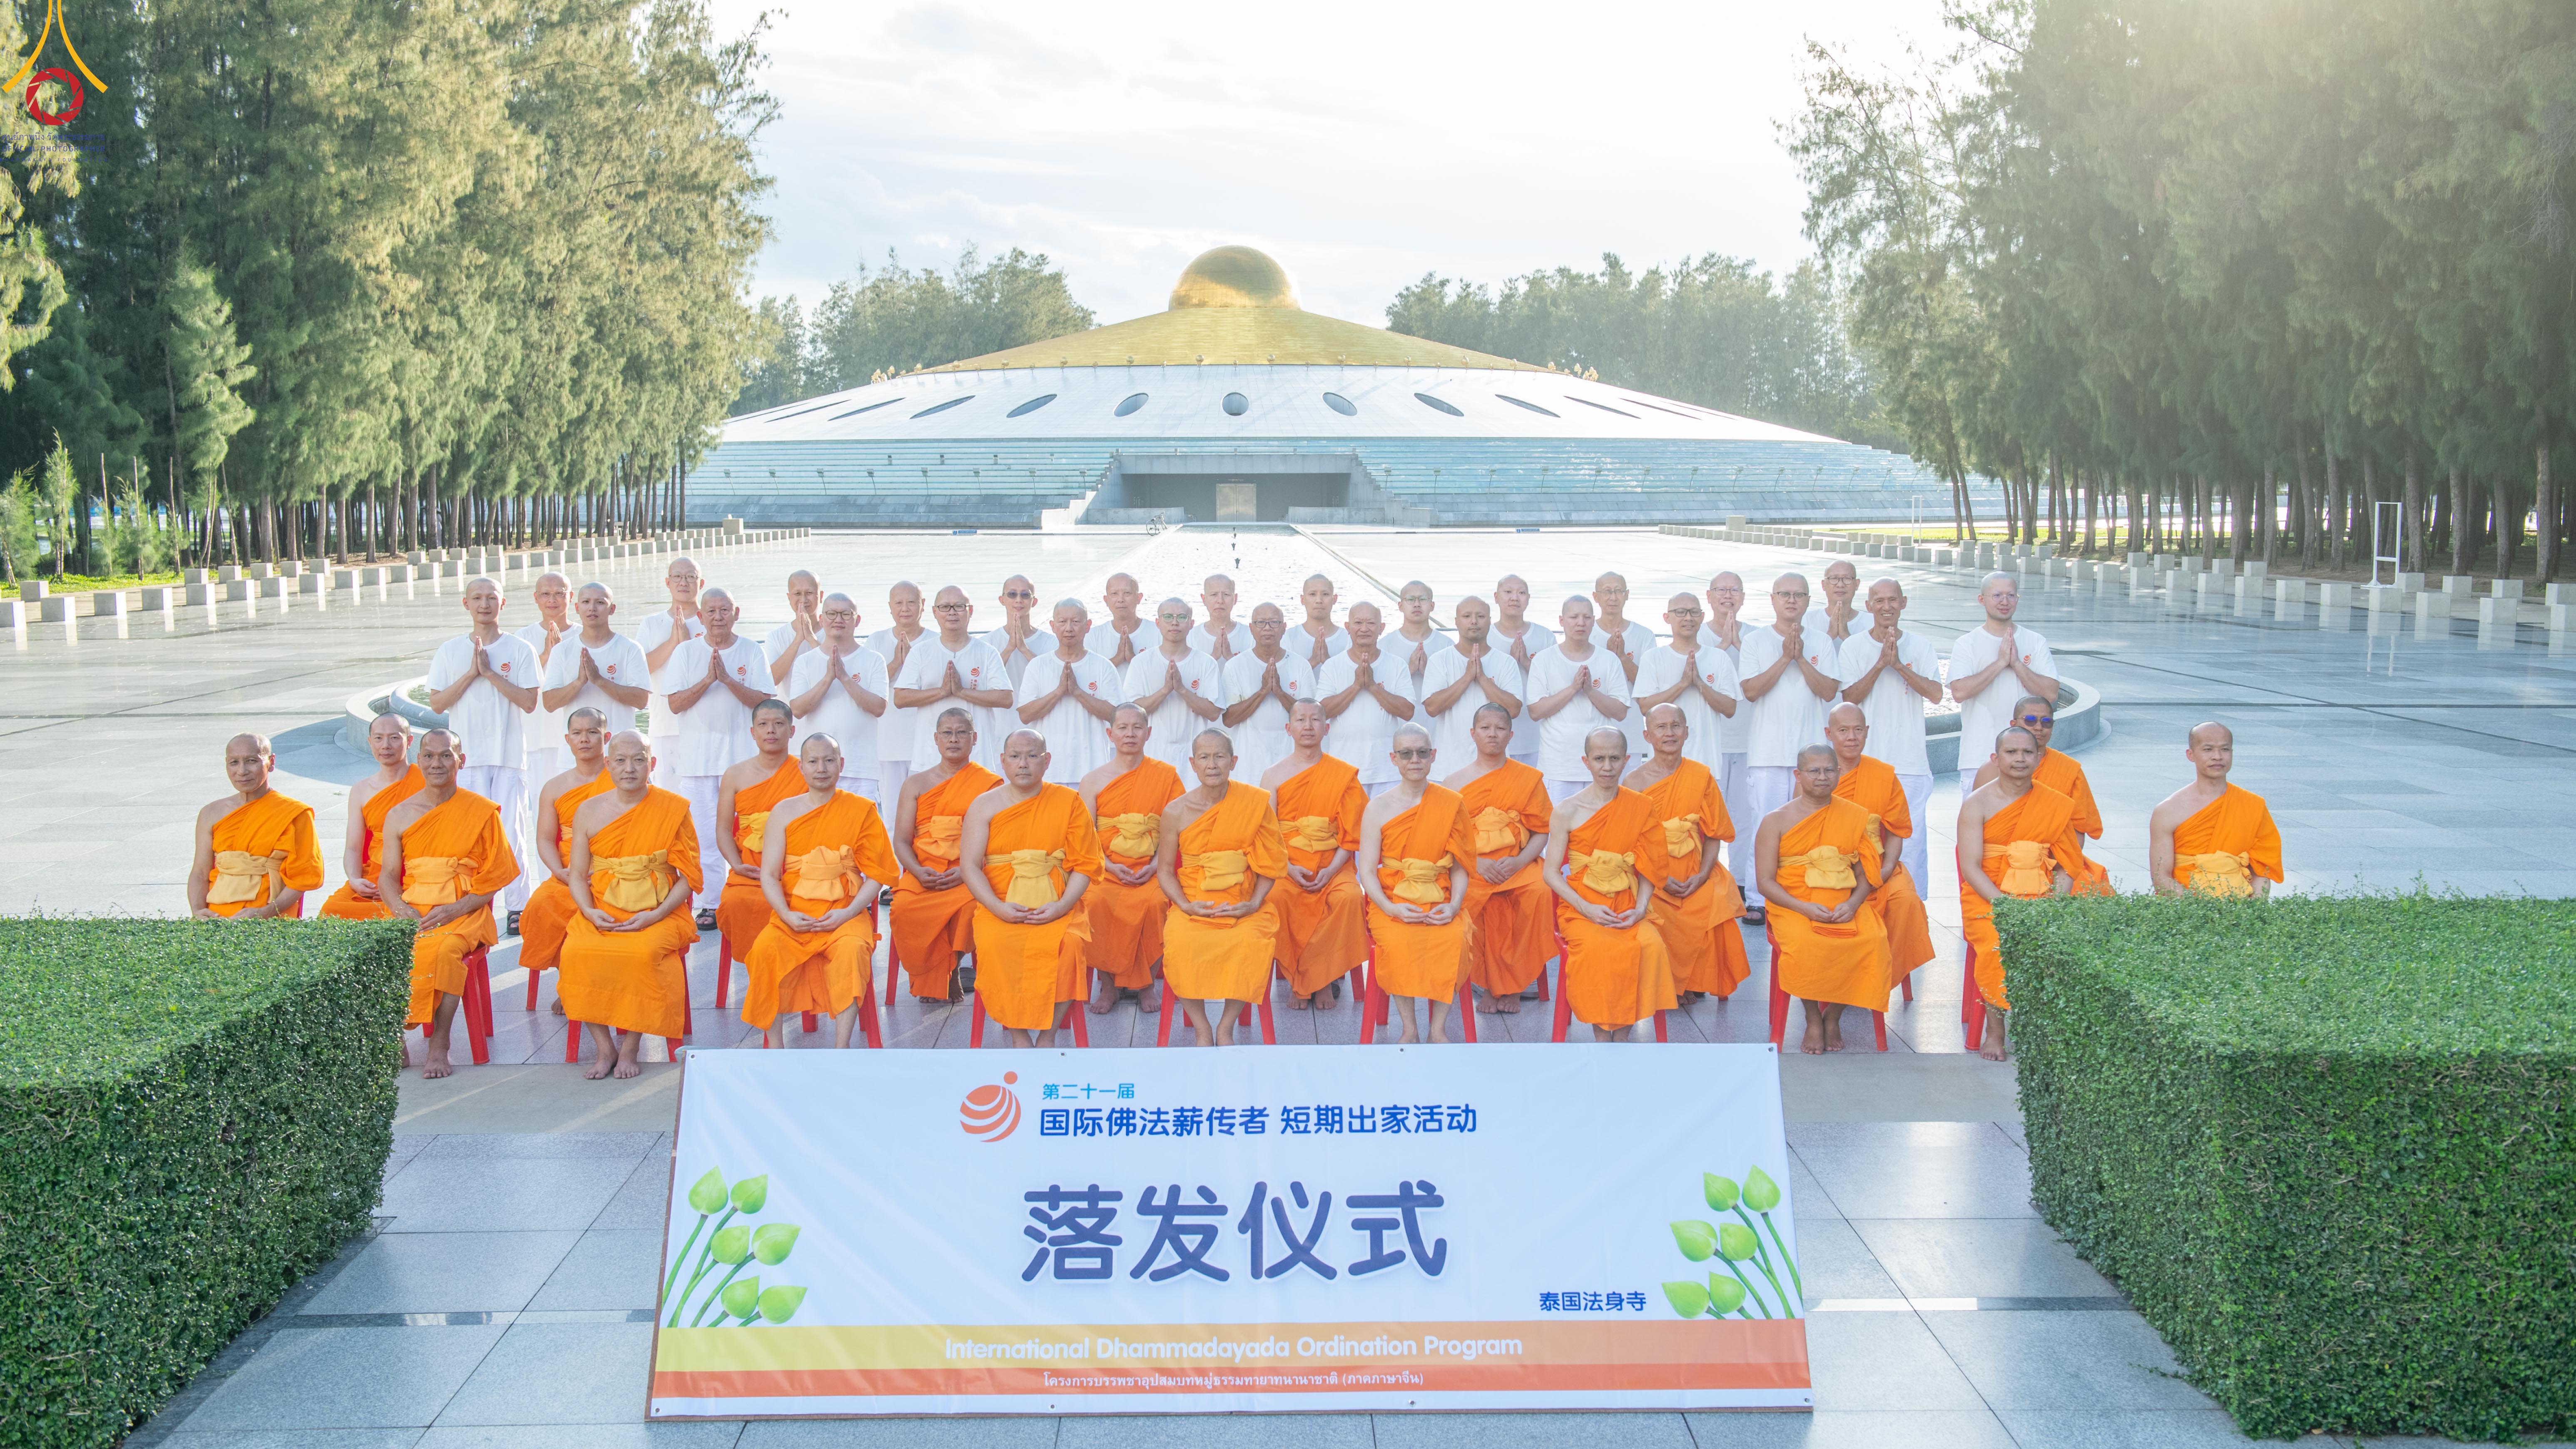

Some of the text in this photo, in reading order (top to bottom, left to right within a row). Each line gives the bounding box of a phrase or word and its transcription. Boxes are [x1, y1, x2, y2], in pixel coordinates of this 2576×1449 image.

[1042, 1083, 1135, 1100] 第二十一届
[1040, 1103, 1477, 1138] 国际佛法薪传者 短期出家活动
[1021, 1179, 1448, 1282] 落发仪式
[1539, 1291, 1646, 1311] 泰国法身寺
[945, 1334, 1523, 1364] International Dhammadayada Ordination Program
[1342, 1370, 1424, 1387] (ภาคภาษาจีน)
